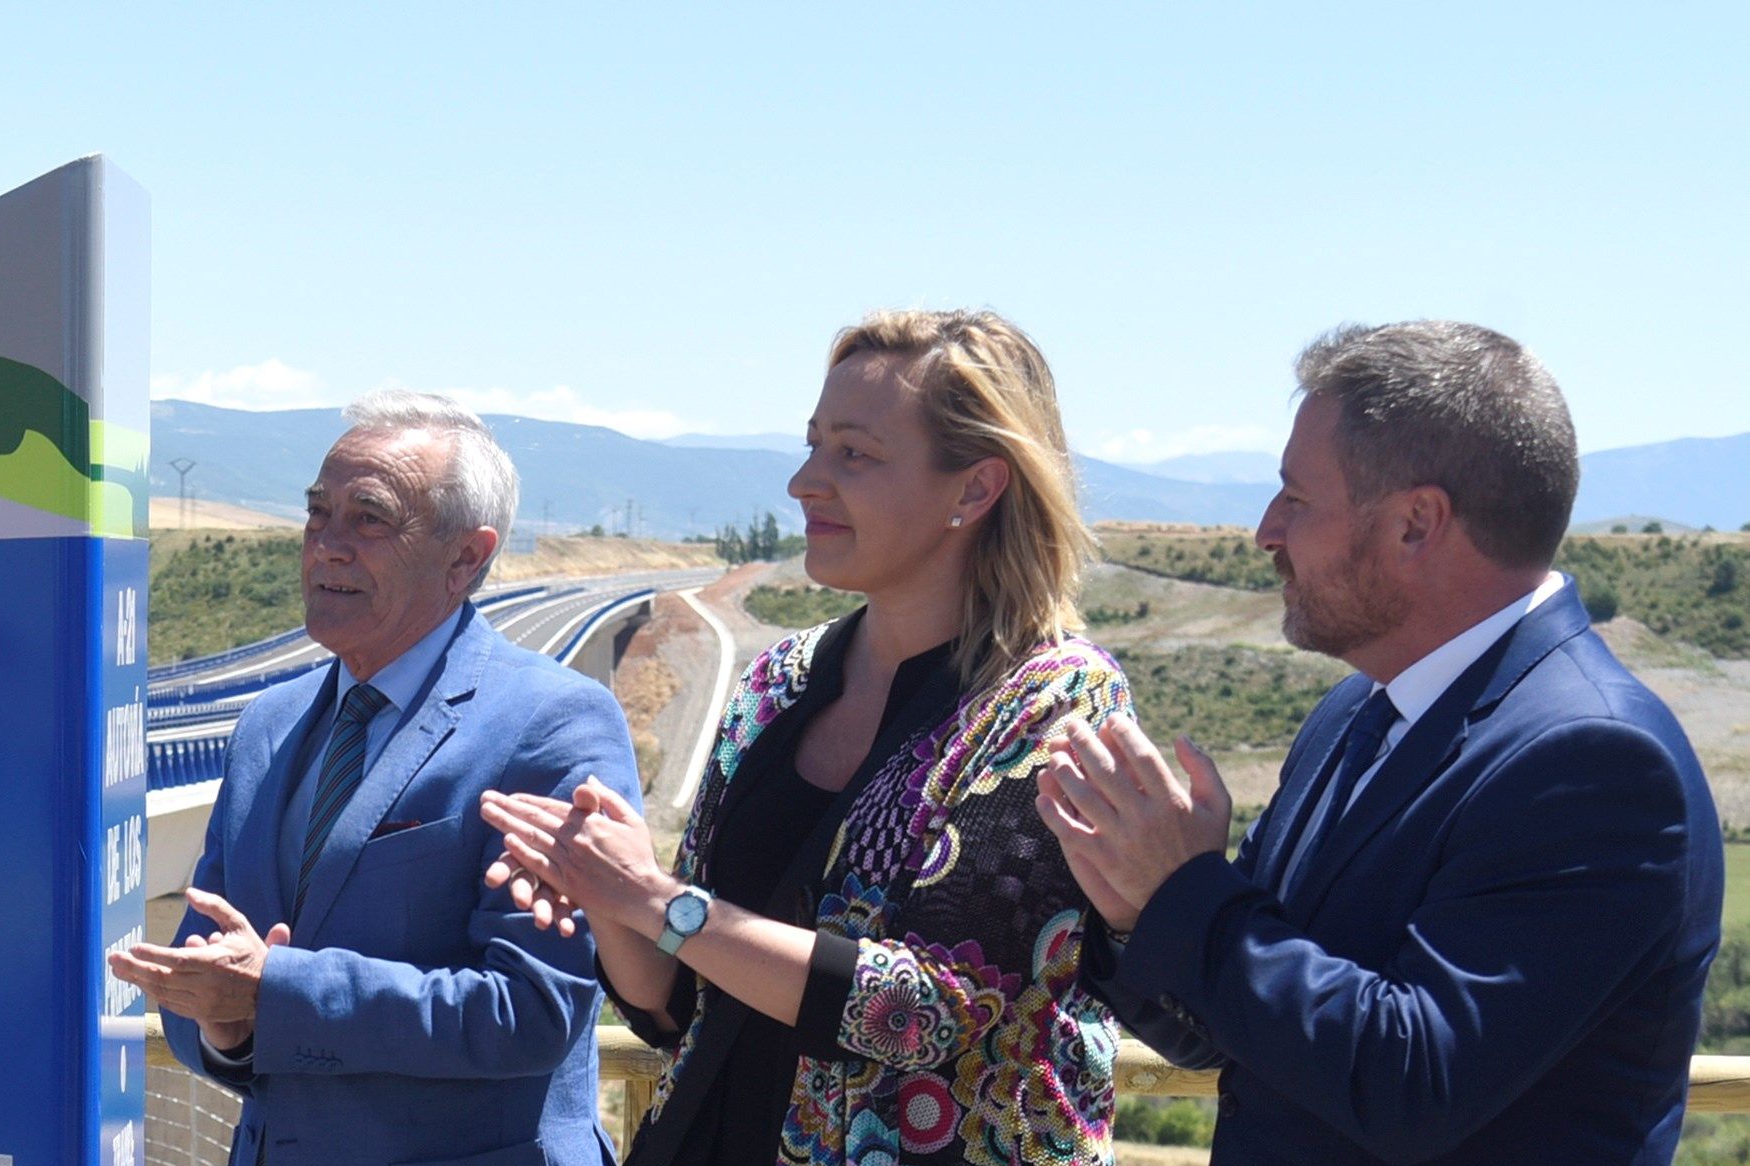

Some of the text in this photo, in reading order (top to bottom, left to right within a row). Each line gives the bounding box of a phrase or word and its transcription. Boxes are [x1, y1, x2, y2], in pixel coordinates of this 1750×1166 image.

[117, 586, 136, 666] A-21
[107, 814, 142, 906] DE LOS
